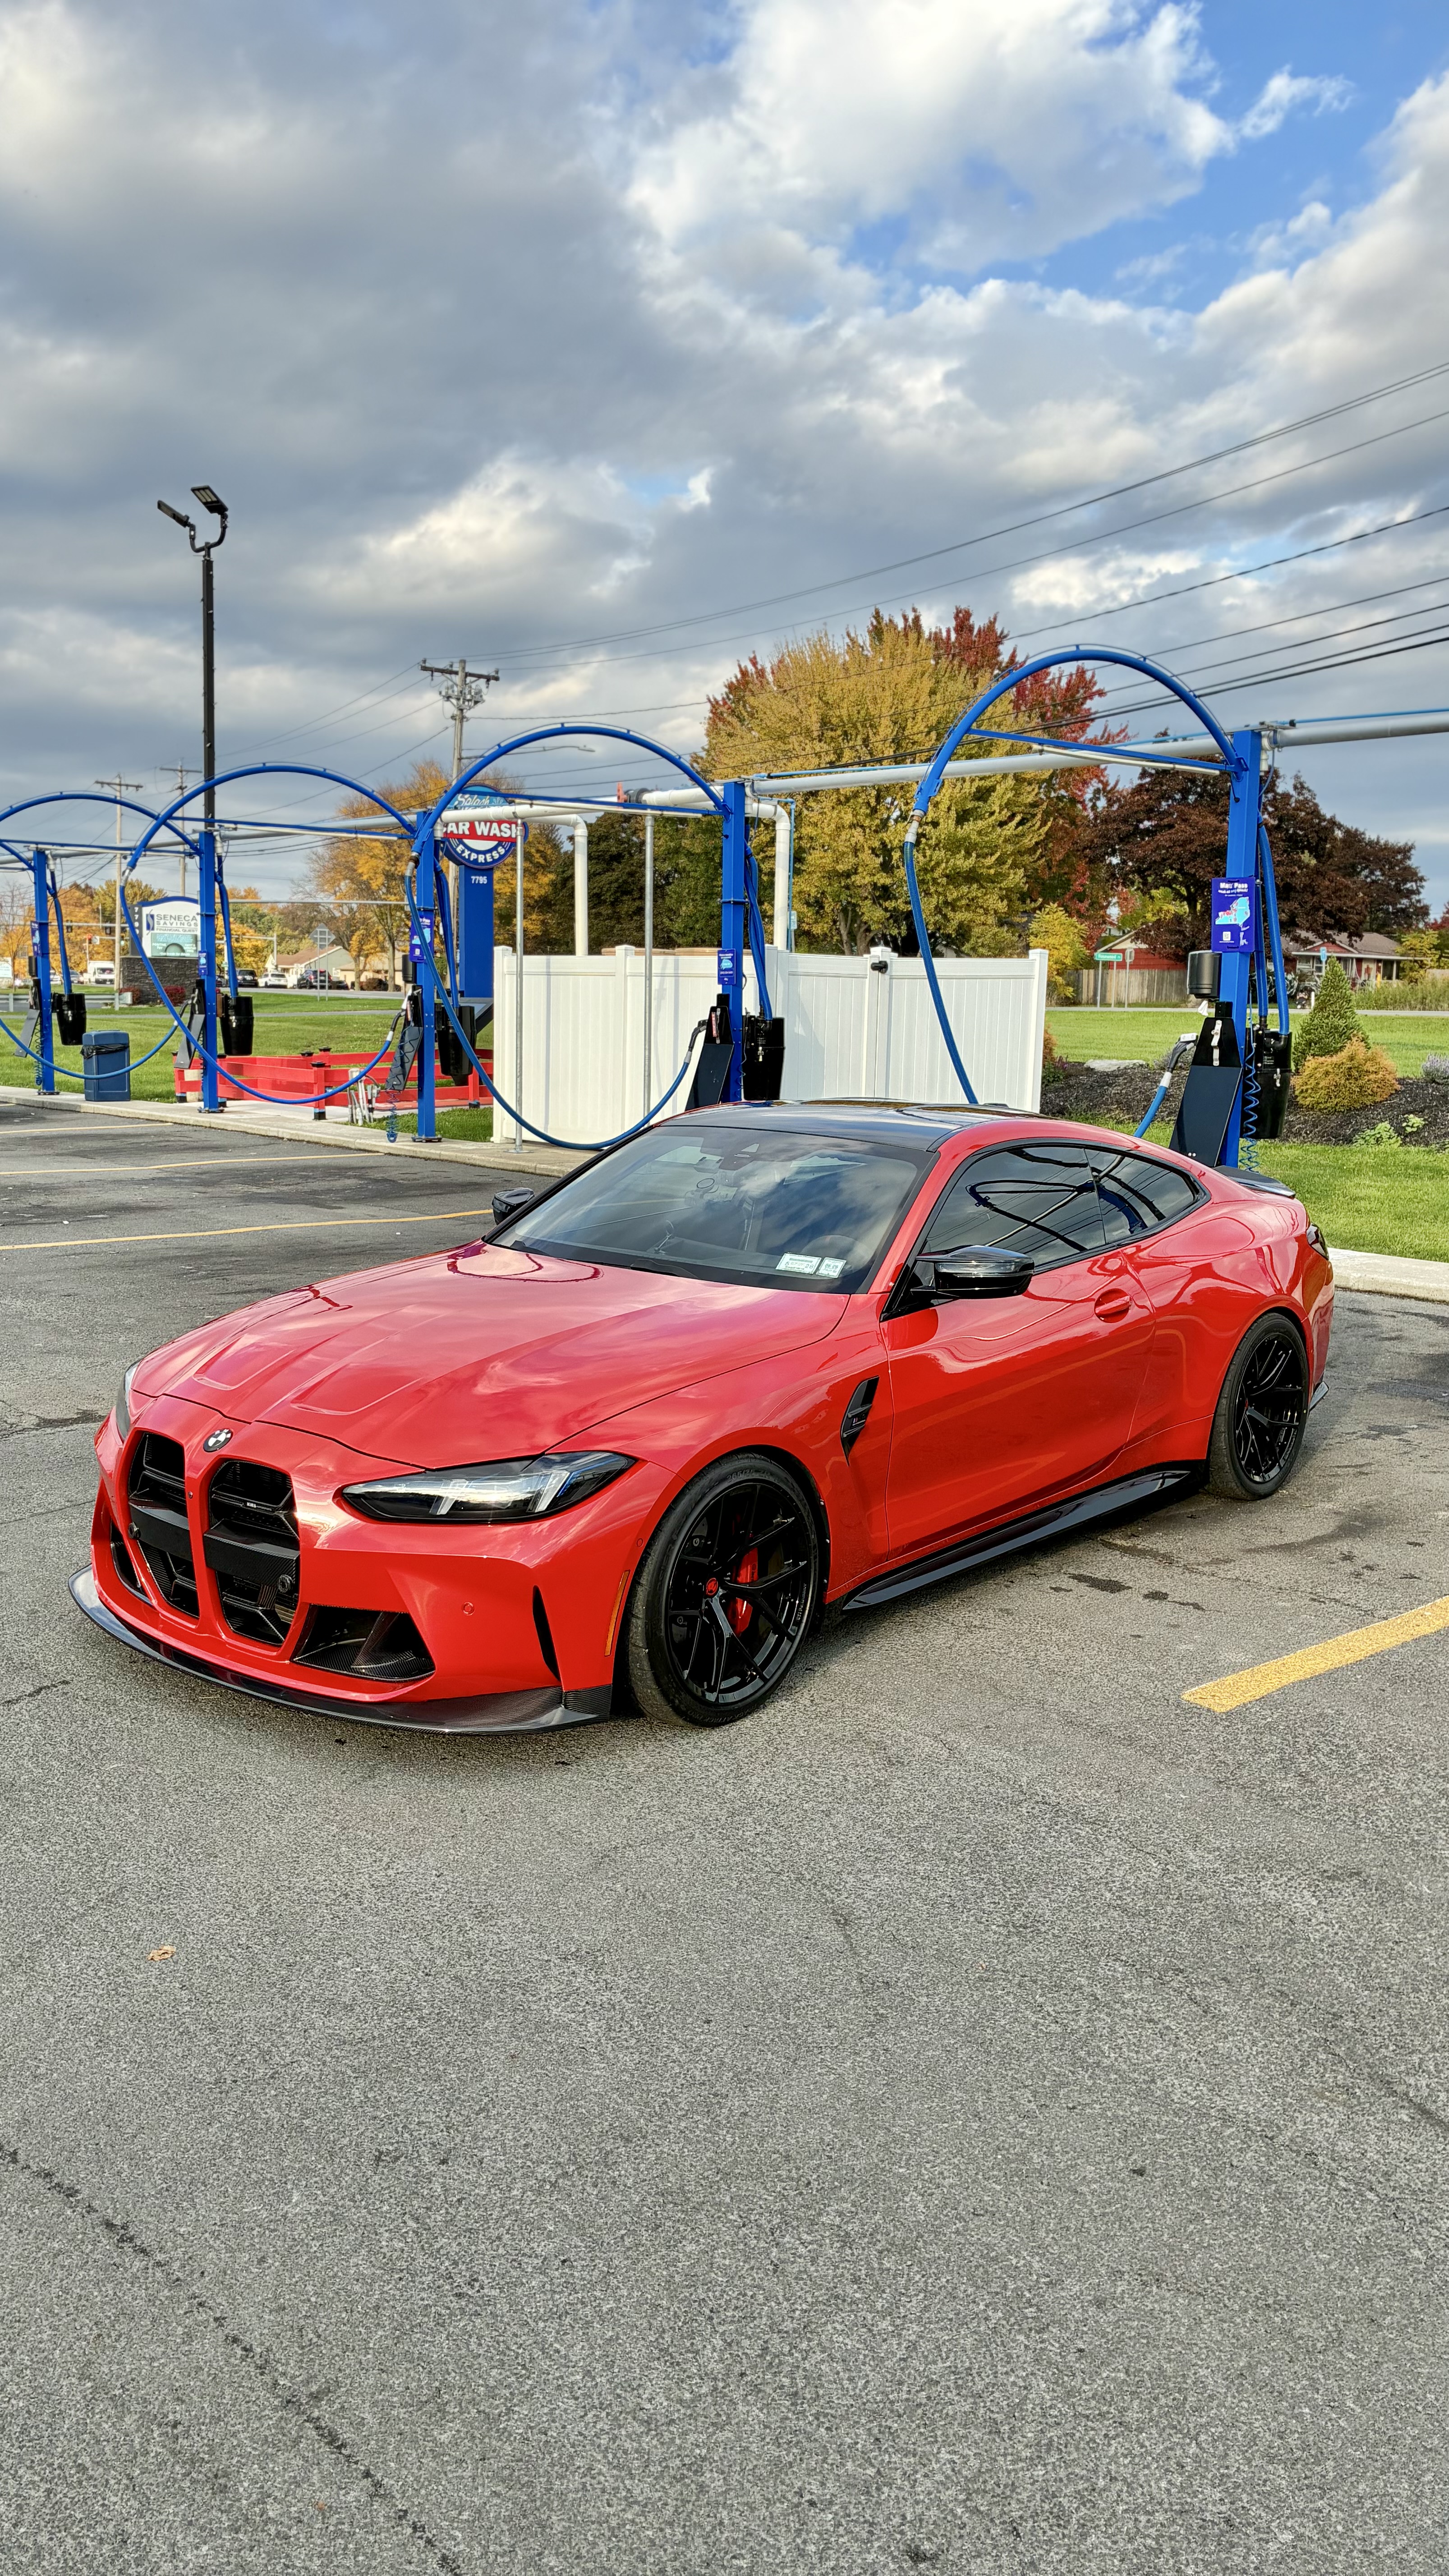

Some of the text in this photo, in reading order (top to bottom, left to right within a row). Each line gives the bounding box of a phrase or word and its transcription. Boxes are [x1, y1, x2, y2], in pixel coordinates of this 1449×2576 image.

[454, 794, 490, 806] Splash
[443, 822, 470, 834] AR
[455, 844, 505, 863] EXPRESS
